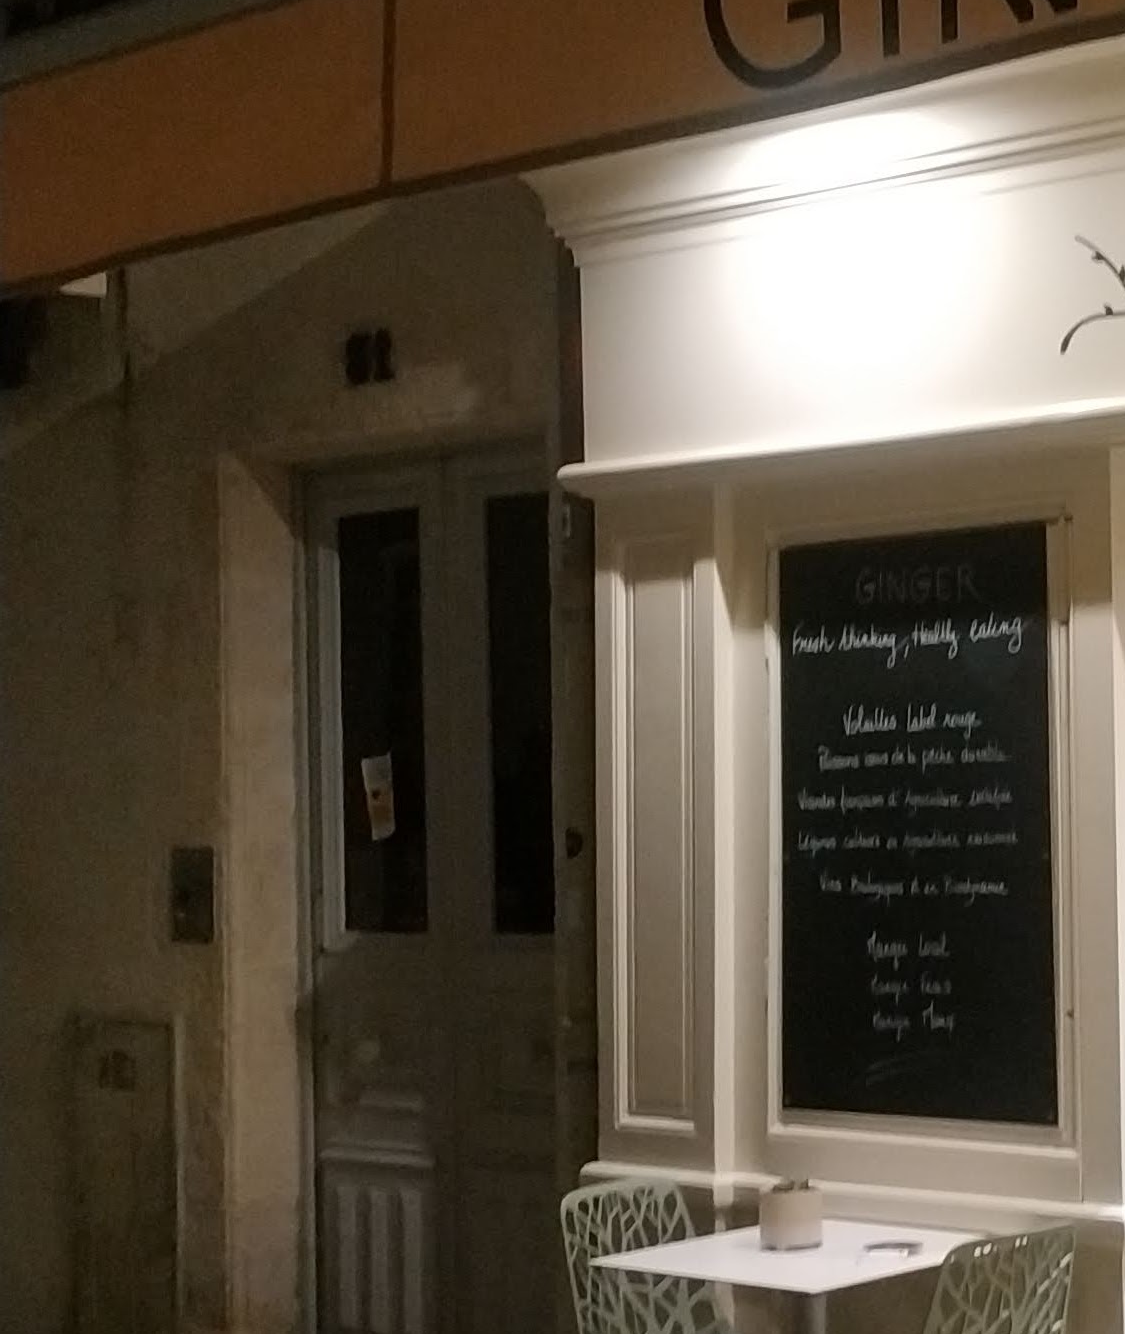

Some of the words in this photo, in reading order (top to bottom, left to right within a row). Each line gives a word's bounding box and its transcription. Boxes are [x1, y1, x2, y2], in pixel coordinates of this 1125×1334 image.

[855, 566, 980, 603] GINGER
[793, 624, 834, 656] Fresh
[970, 611, 1022, 654] eating
